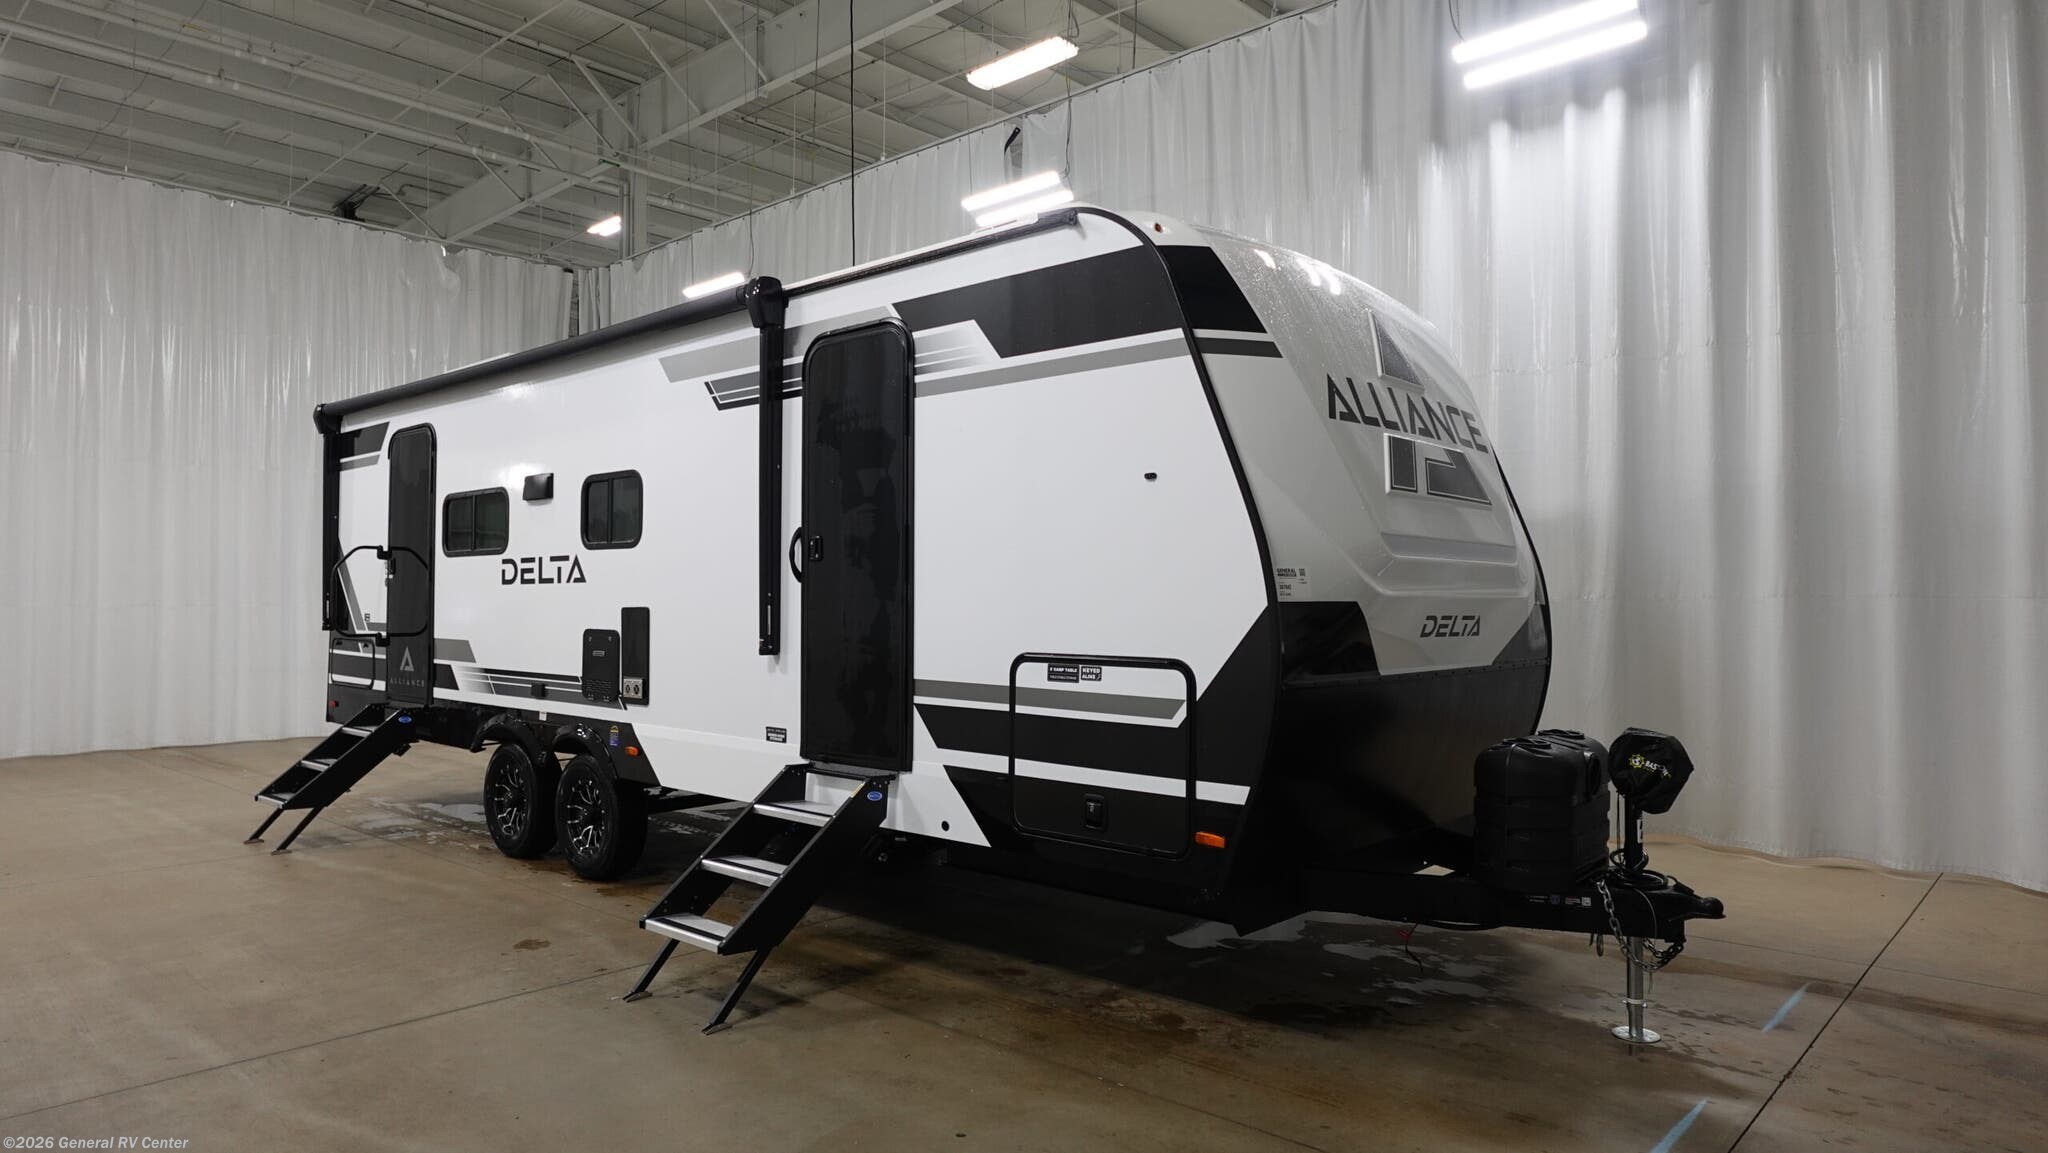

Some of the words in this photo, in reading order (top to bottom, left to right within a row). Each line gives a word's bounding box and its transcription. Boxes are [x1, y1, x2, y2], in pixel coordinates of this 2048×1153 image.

[1327, 373, 1489, 453] ALLIANCE
[501, 555, 587, 585] DELTA
[1420, 615, 1481, 638] DELTA
[390, 677, 425, 688] ALLIANCE
